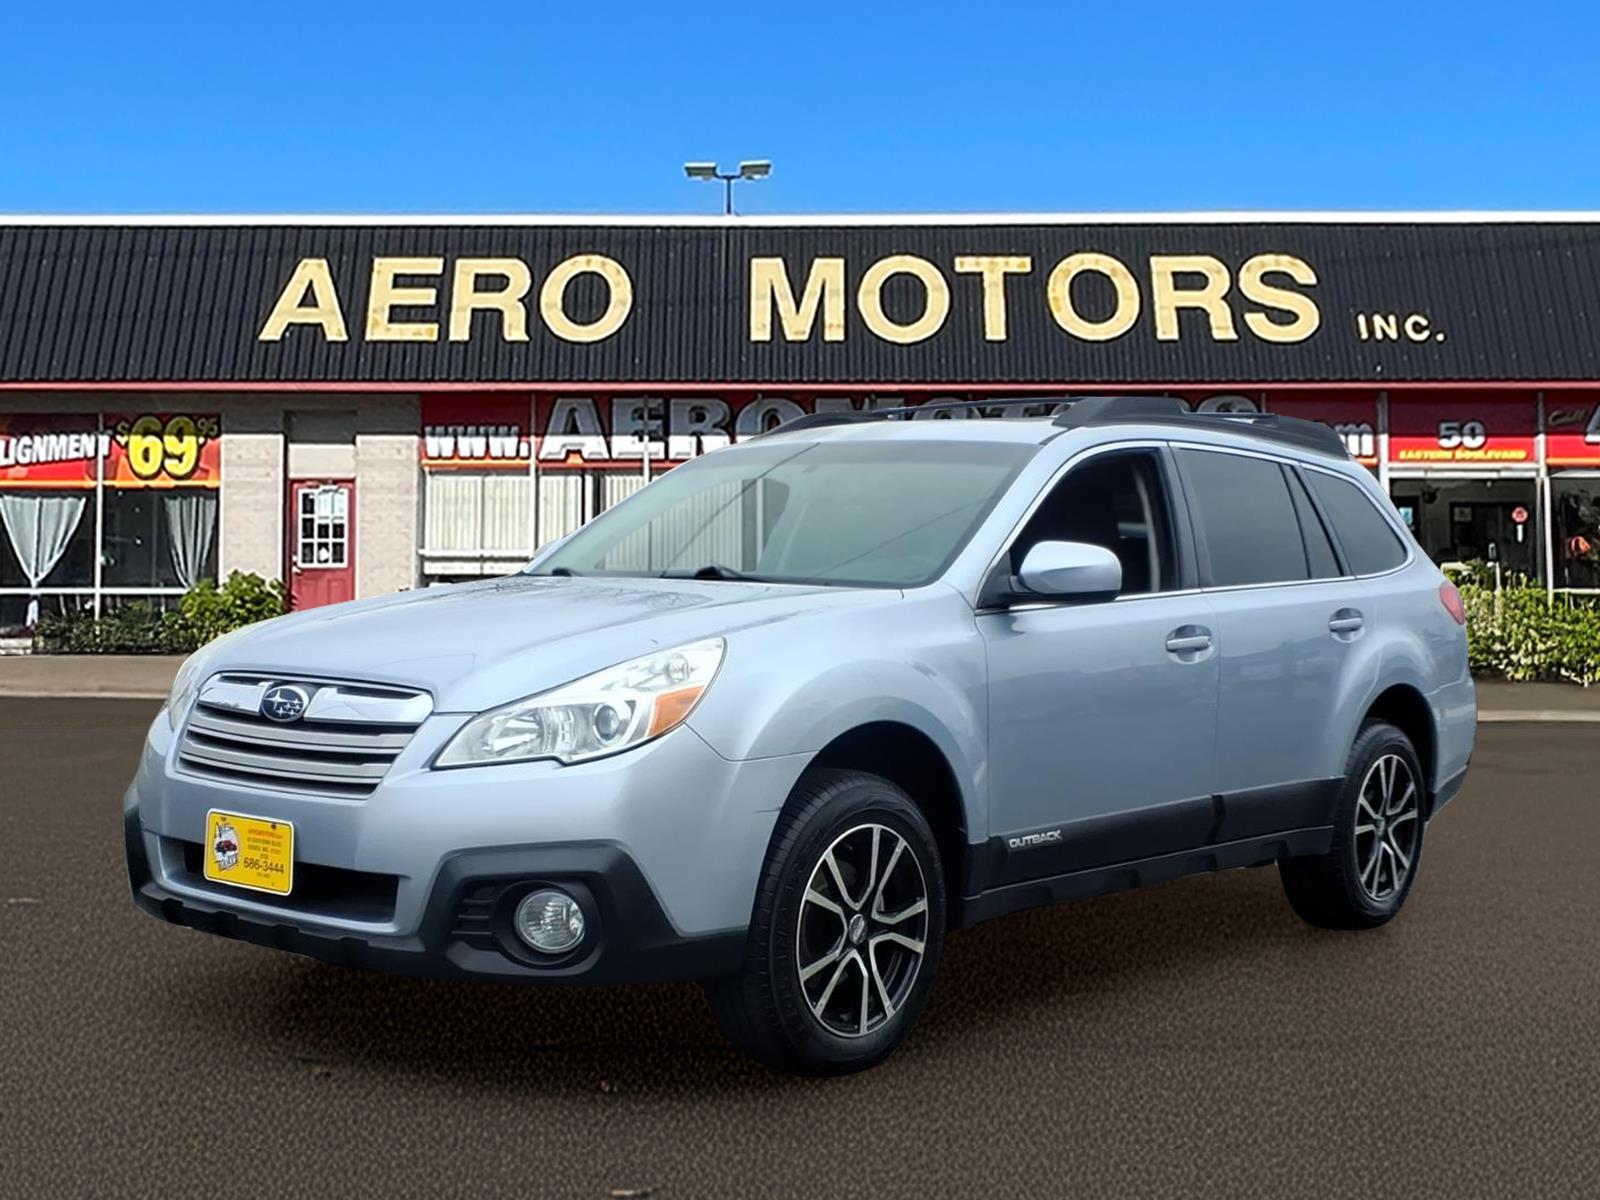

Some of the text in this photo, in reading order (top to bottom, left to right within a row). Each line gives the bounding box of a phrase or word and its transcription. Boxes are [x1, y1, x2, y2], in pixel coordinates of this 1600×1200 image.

[258, 253, 1447, 345] AERO MOTORS INC.
[1438, 422, 1486, 449] 50
[1399, 450, 1527, 460] EASTERN BOULEVARD
[1008, 829, 1062, 848] OUTBACK
[243, 856, 285, 874] 686-3444
